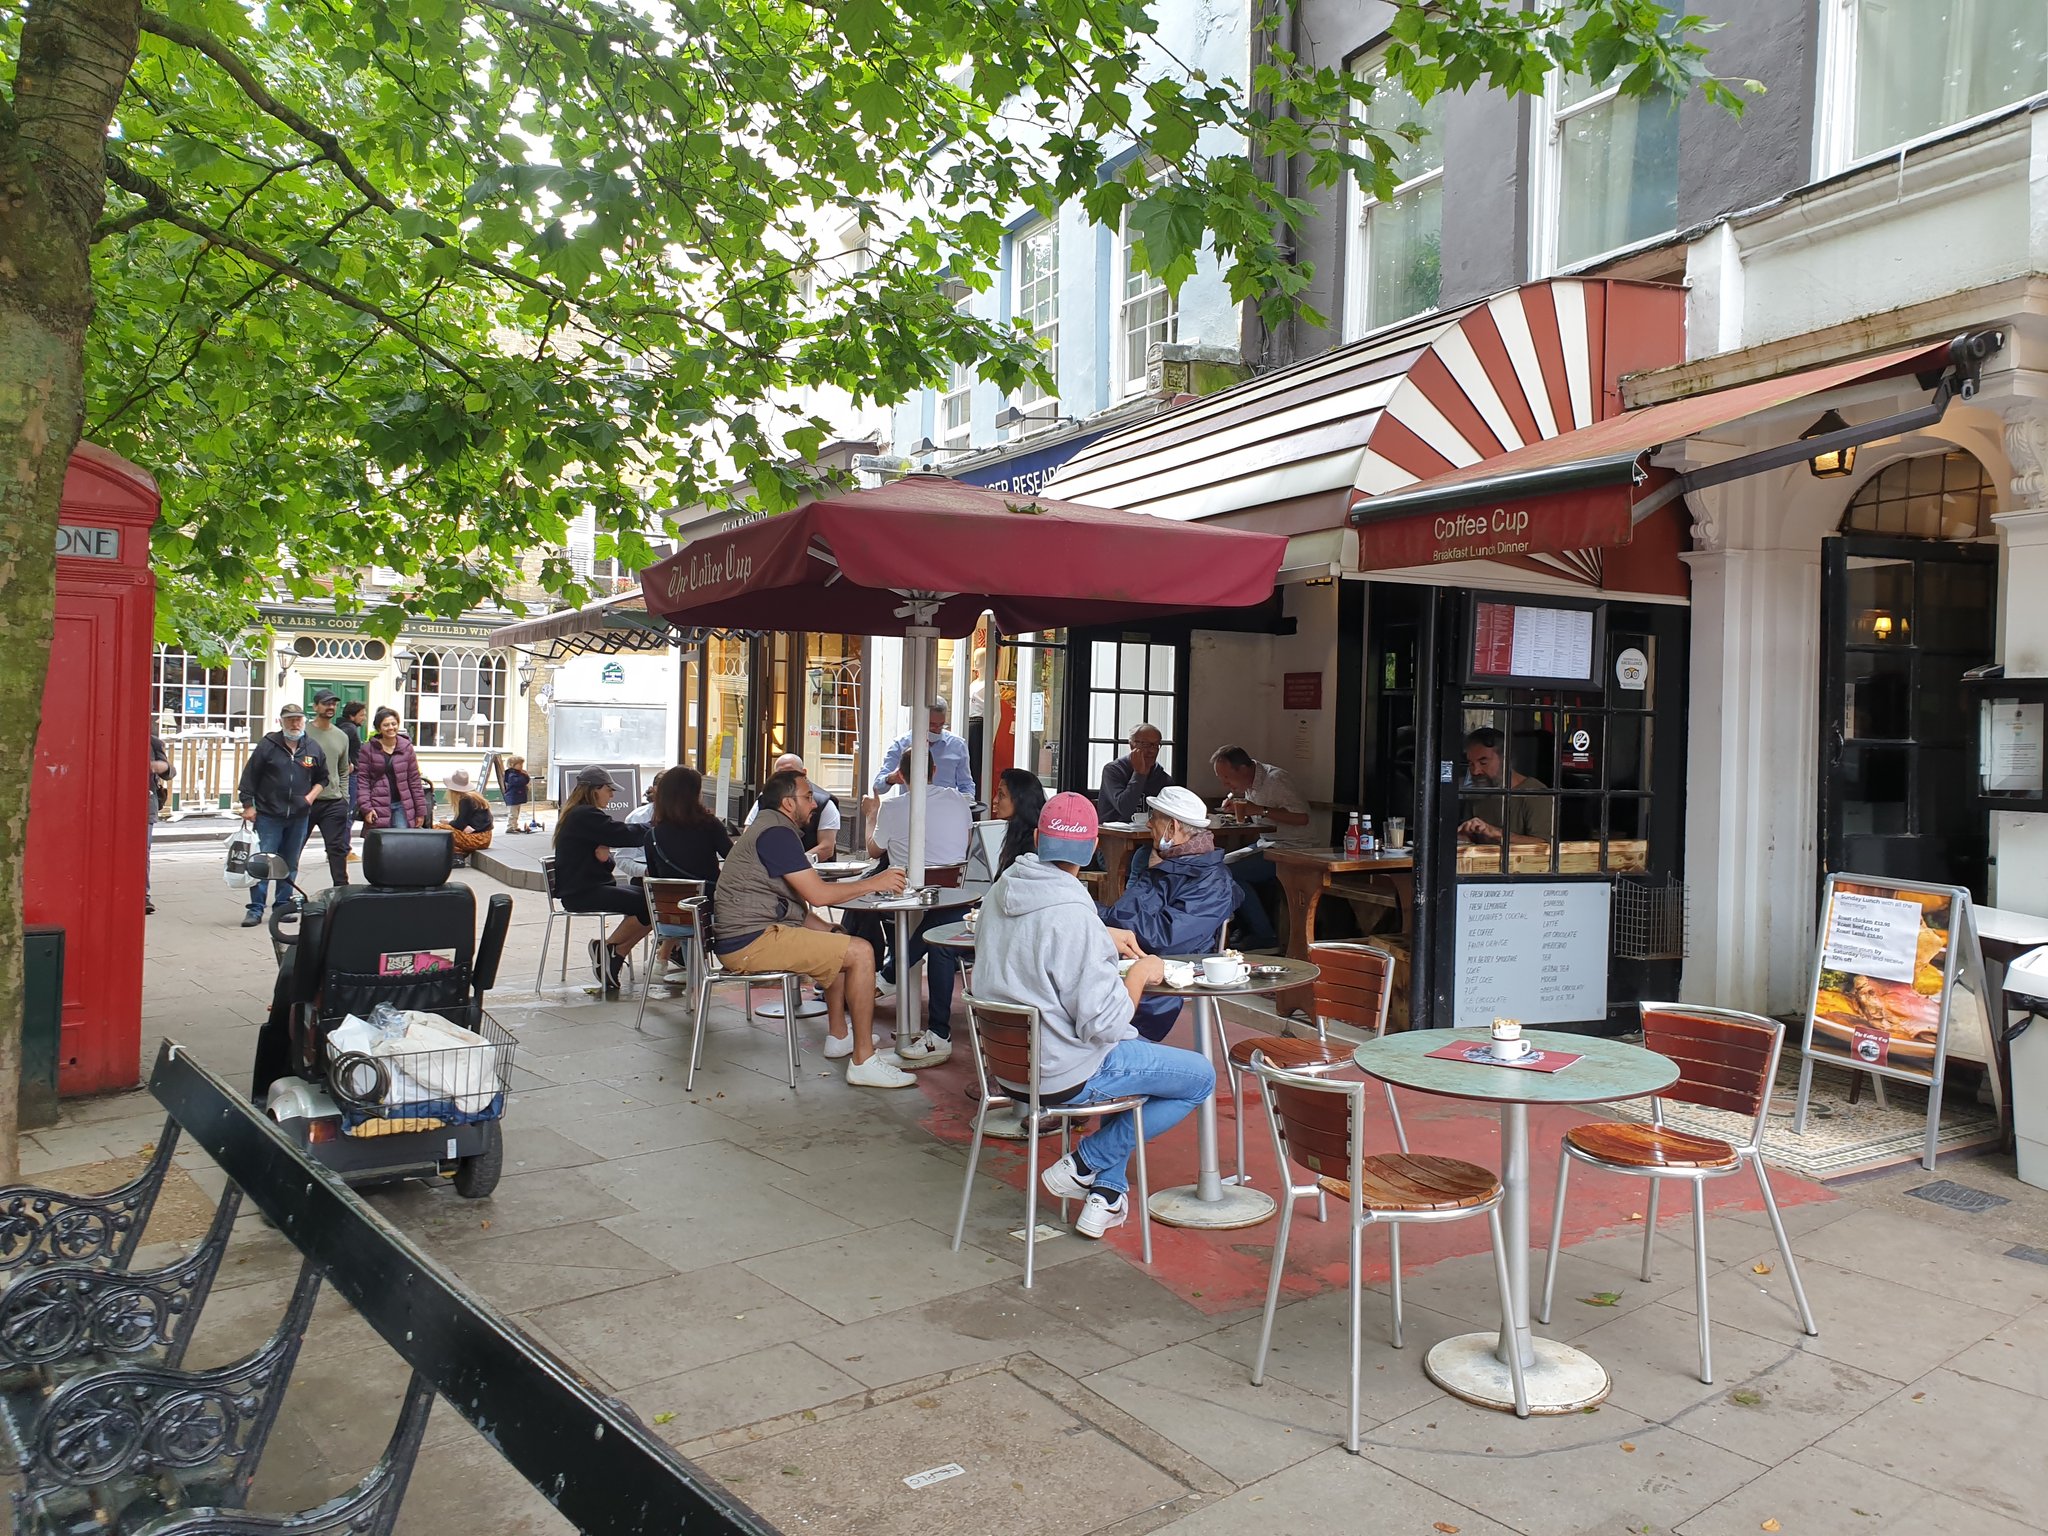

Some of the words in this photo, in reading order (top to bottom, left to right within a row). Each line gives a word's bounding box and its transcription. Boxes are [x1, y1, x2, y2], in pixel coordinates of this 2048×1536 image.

[1434, 513, 1488, 540] Coffee
[1492, 508, 1529, 536] Cup
[56, 527, 113, 556] ONE
[1433, 546, 1468, 561] Breakfast
[1470, 543, 1496, 557] Lunch
[1497, 541, 1529, 554] Dinner
[668, 565, 688, 604] The
[690, 552, 723, 591] Coffee
[726, 543, 752, 584] Cup
[256, 614, 285, 625] CASK
[288, 617, 317, 627] ALES
[327, 619, 360, 629] COOL
[419, 624, 467, 635] CHILLED
[469, 627, 493, 636] WIN
[1048, 818, 1088, 833] London
[1841, 894, 1862, 902] Sunday
[1837, 921, 1852, 929] Roast
[1852, 916, 1873, 925] chicken
[1833, 948, 1859, 958] Saturday
